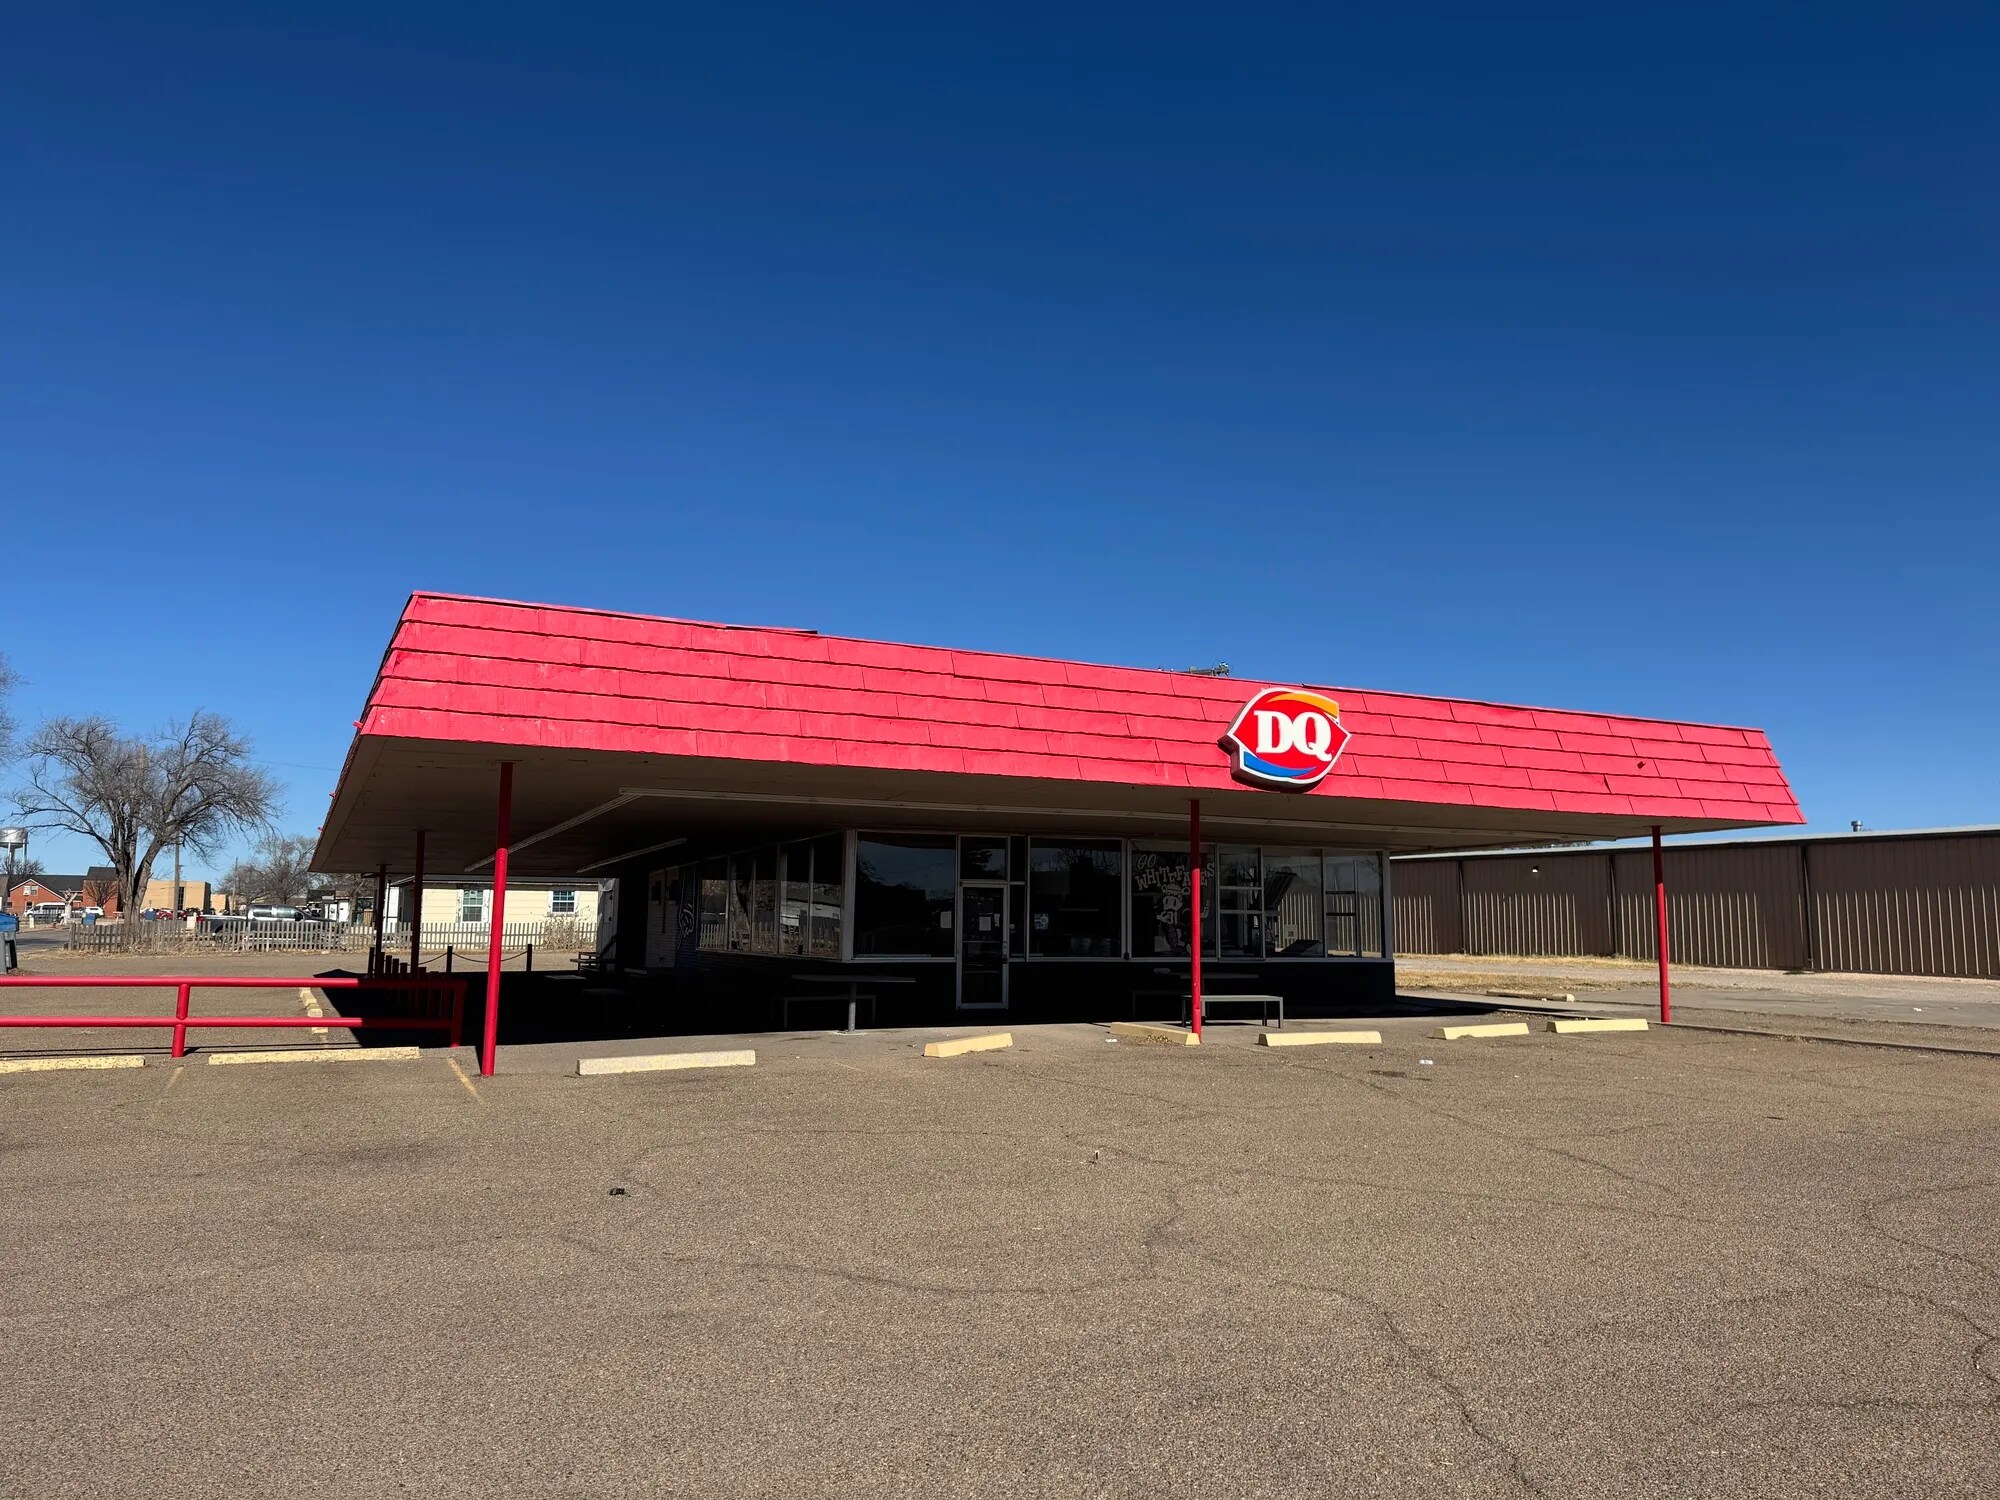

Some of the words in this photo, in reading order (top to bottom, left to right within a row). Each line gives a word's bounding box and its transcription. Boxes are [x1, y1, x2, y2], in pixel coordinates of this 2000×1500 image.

[1254, 710, 1333, 762] DQ
[1135, 861, 1215, 891] WHITEFAES
[1137, 854, 1156, 870] GO
